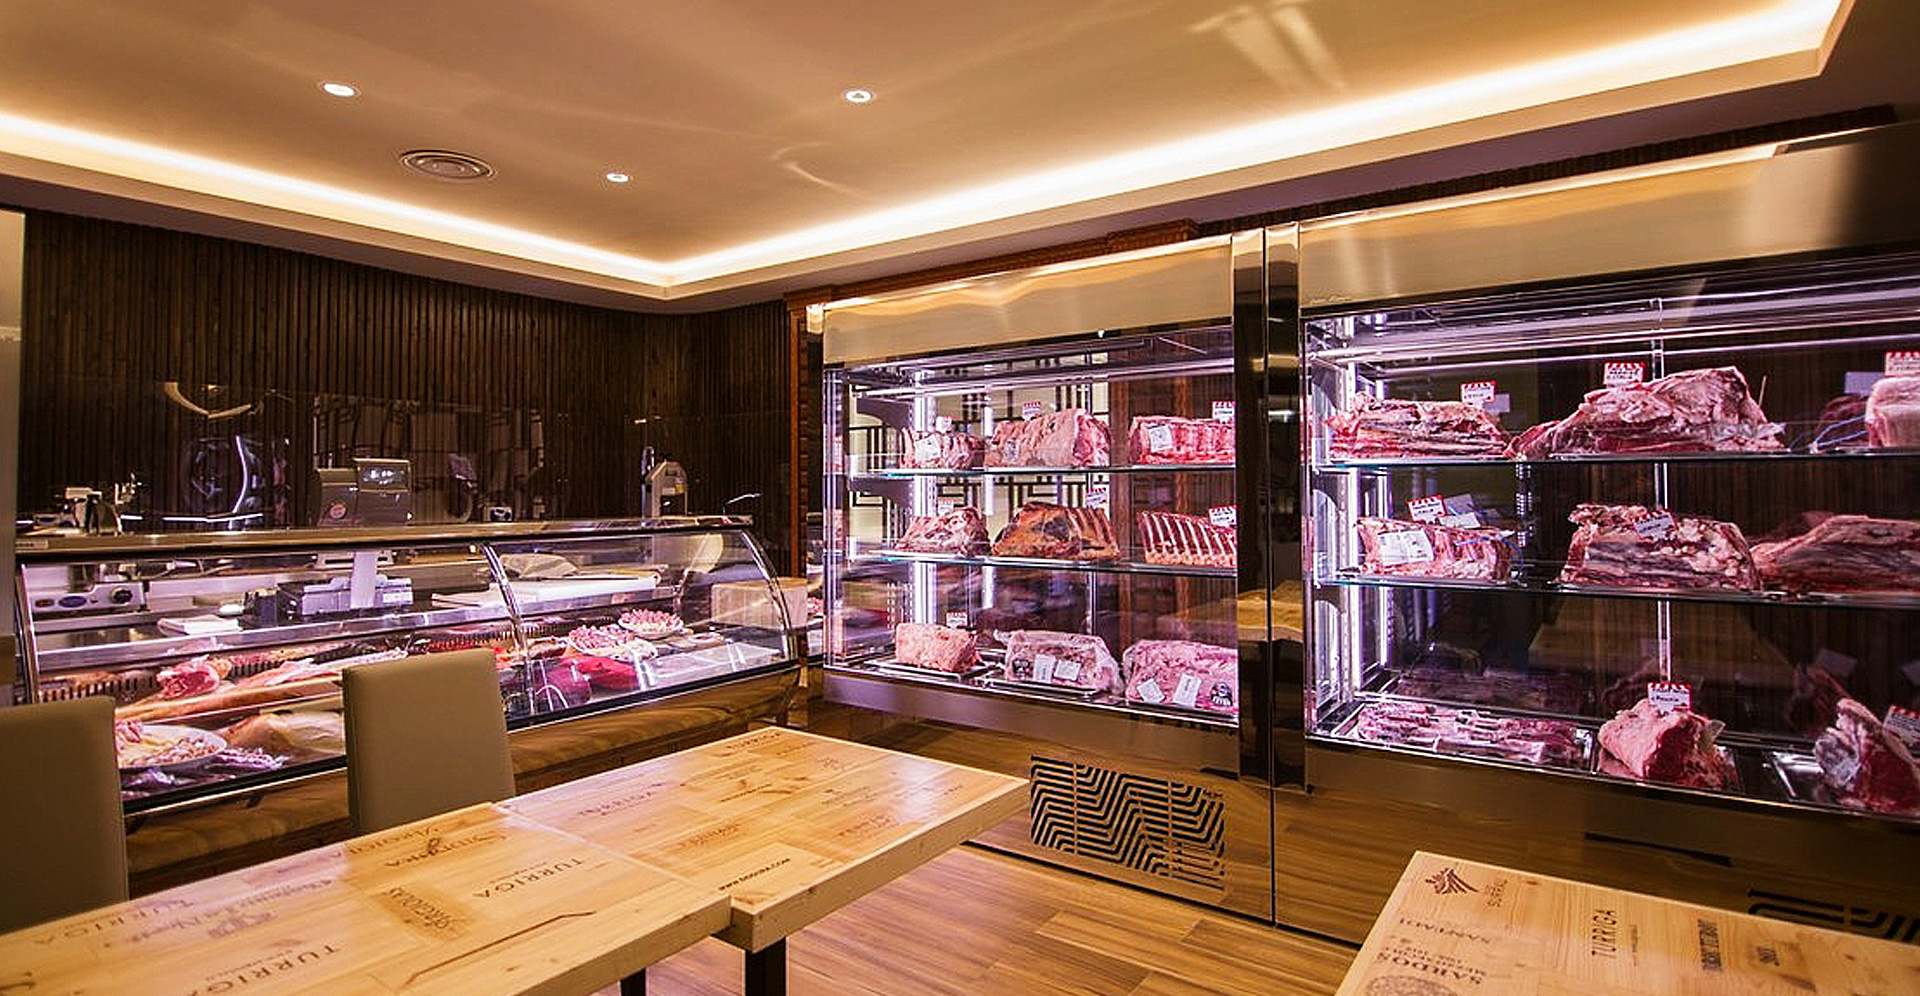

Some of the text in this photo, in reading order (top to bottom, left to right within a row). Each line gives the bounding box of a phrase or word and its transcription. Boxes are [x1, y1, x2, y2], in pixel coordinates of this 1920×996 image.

[472, 857, 585, 899] TURRIGA
[1591, 909, 1617, 959] TURRIGA
[186, 943, 342, 996] TURRIG
